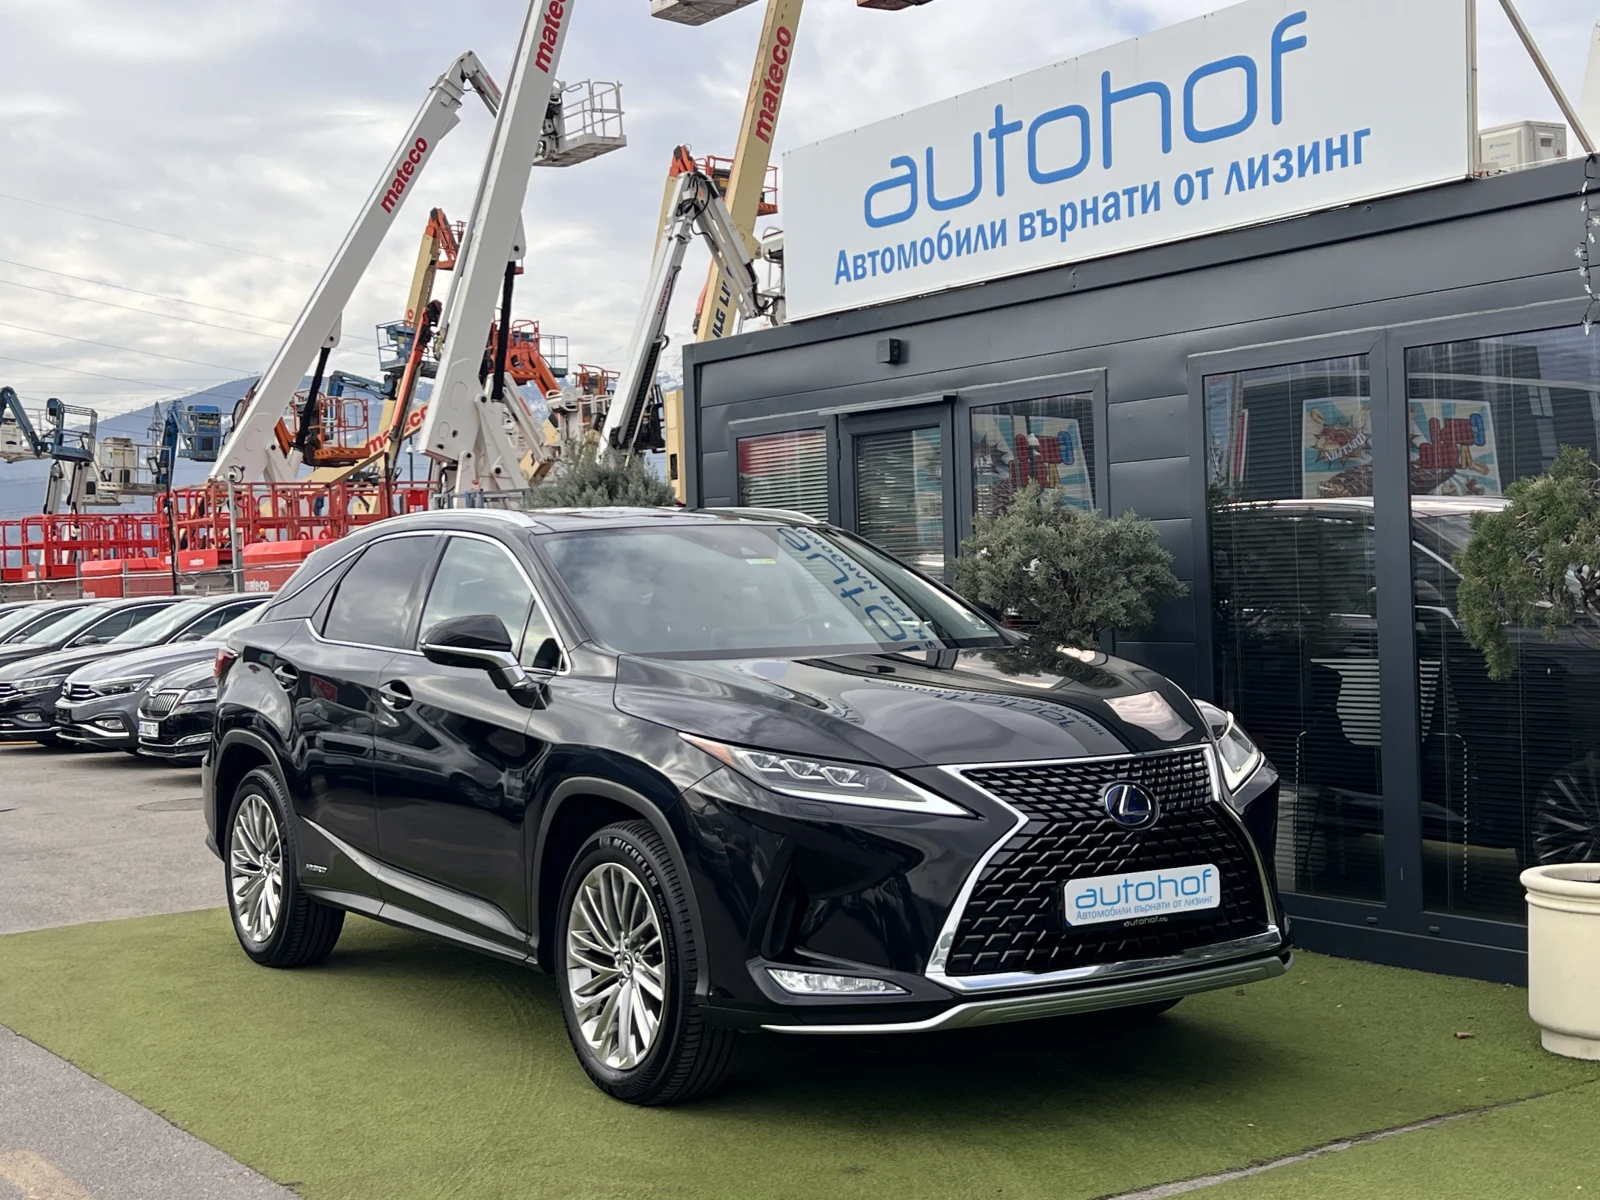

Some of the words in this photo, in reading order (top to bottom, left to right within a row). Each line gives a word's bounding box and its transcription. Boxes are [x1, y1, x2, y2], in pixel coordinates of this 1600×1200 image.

[755, 25, 791, 144] mateco
[864, 10, 1307, 228] autohof
[380, 137, 427, 214] mateco
[835, 220, 1007, 285] Автомобили
[1029, 180, 1161, 243] върнати
[1173, 167, 1214, 206] от
[1224, 128, 1371, 196] лизинг
[612, 838, 658, 887] MICHELIN
[656, 893, 669, 919] PILOT
[1075, 868, 1212, 909] autohof
[1076, 905, 1132, 920] Автомобили
[1134, 902, 1171, 914] върнати
[1173, 900, 1182, 909] от
[1184, 895, 1213, 906] лизинг
